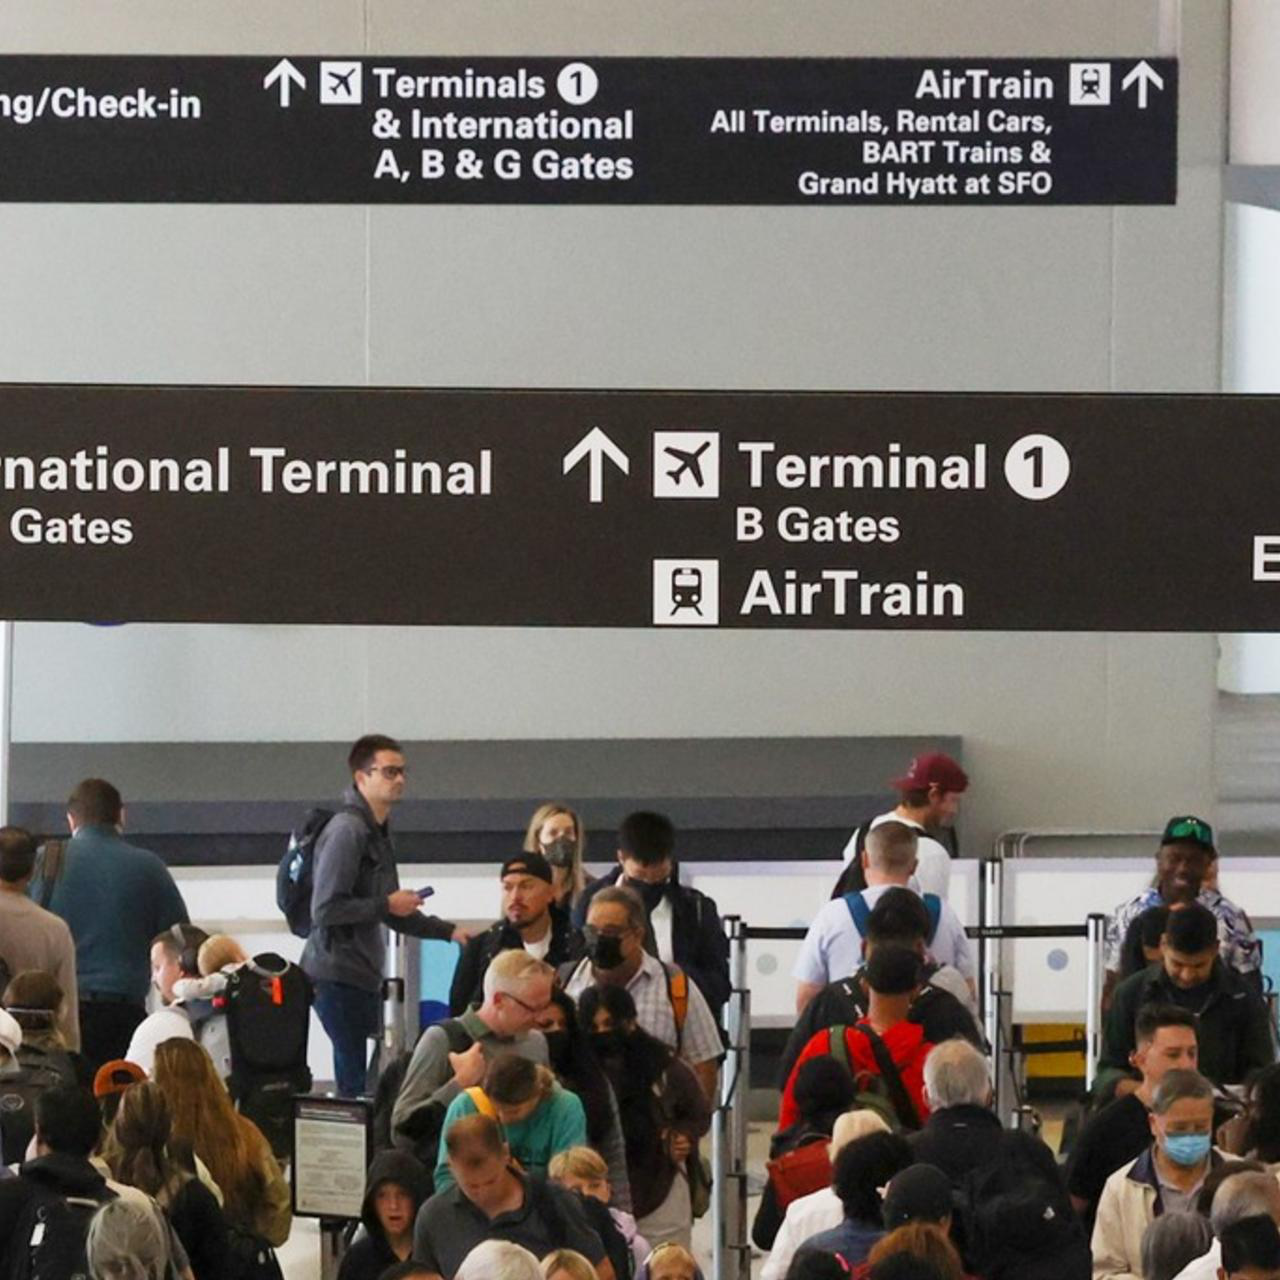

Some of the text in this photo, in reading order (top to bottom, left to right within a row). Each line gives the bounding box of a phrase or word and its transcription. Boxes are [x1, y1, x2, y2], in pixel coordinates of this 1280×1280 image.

[373, 67, 546, 99] Terminals
[916, 69, 1054, 99] AirTrain
[372, 108, 633, 140] & International
[710, 110, 1052, 136] All Terminals, Rental Cars,
[374, 148, 634, 182] A, B & G Gates
[862, 140, 1052, 164] BART Trains &
[798, 171, 1052, 200] Grand Hyatt at SFO
[250, 448, 492, 495] Terminal
[738, 442, 986, 490] Terminal
[10, 508, 133, 545] Gates
[737, 508, 900, 543] B Gates
[740, 569, 964, 616] AirTrain
